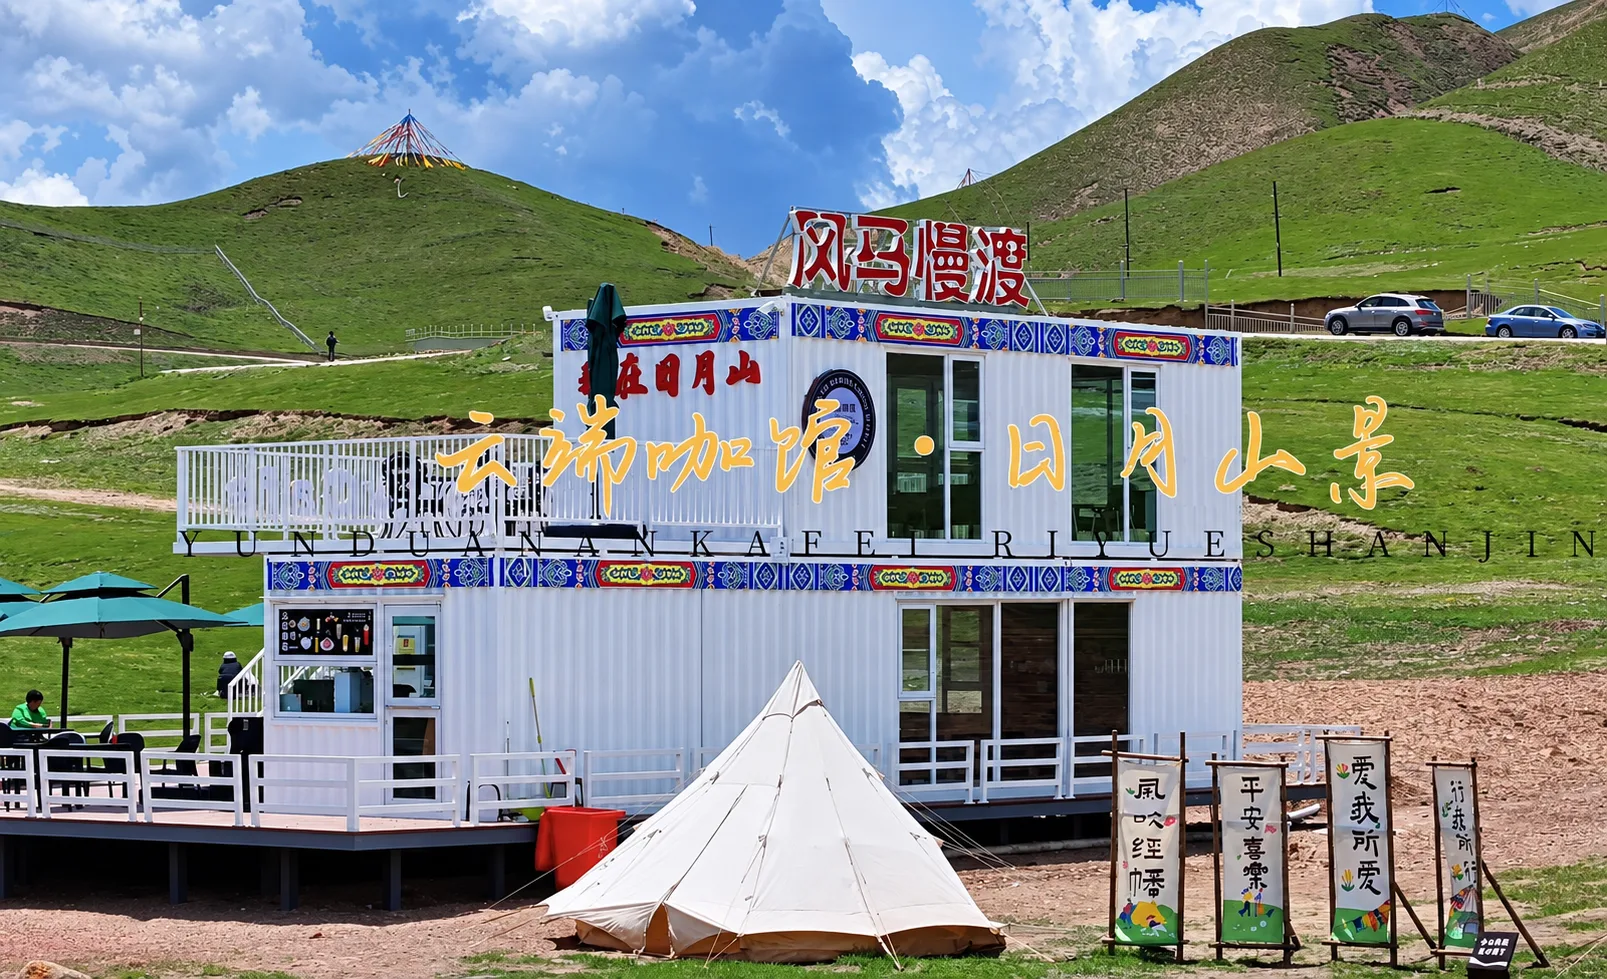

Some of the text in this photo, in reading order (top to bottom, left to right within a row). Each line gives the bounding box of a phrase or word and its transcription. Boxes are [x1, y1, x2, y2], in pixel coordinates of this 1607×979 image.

[787, 208, 1031, 308] 风马慢渡
[1350, 755, 1382, 896] 爱我所爱
